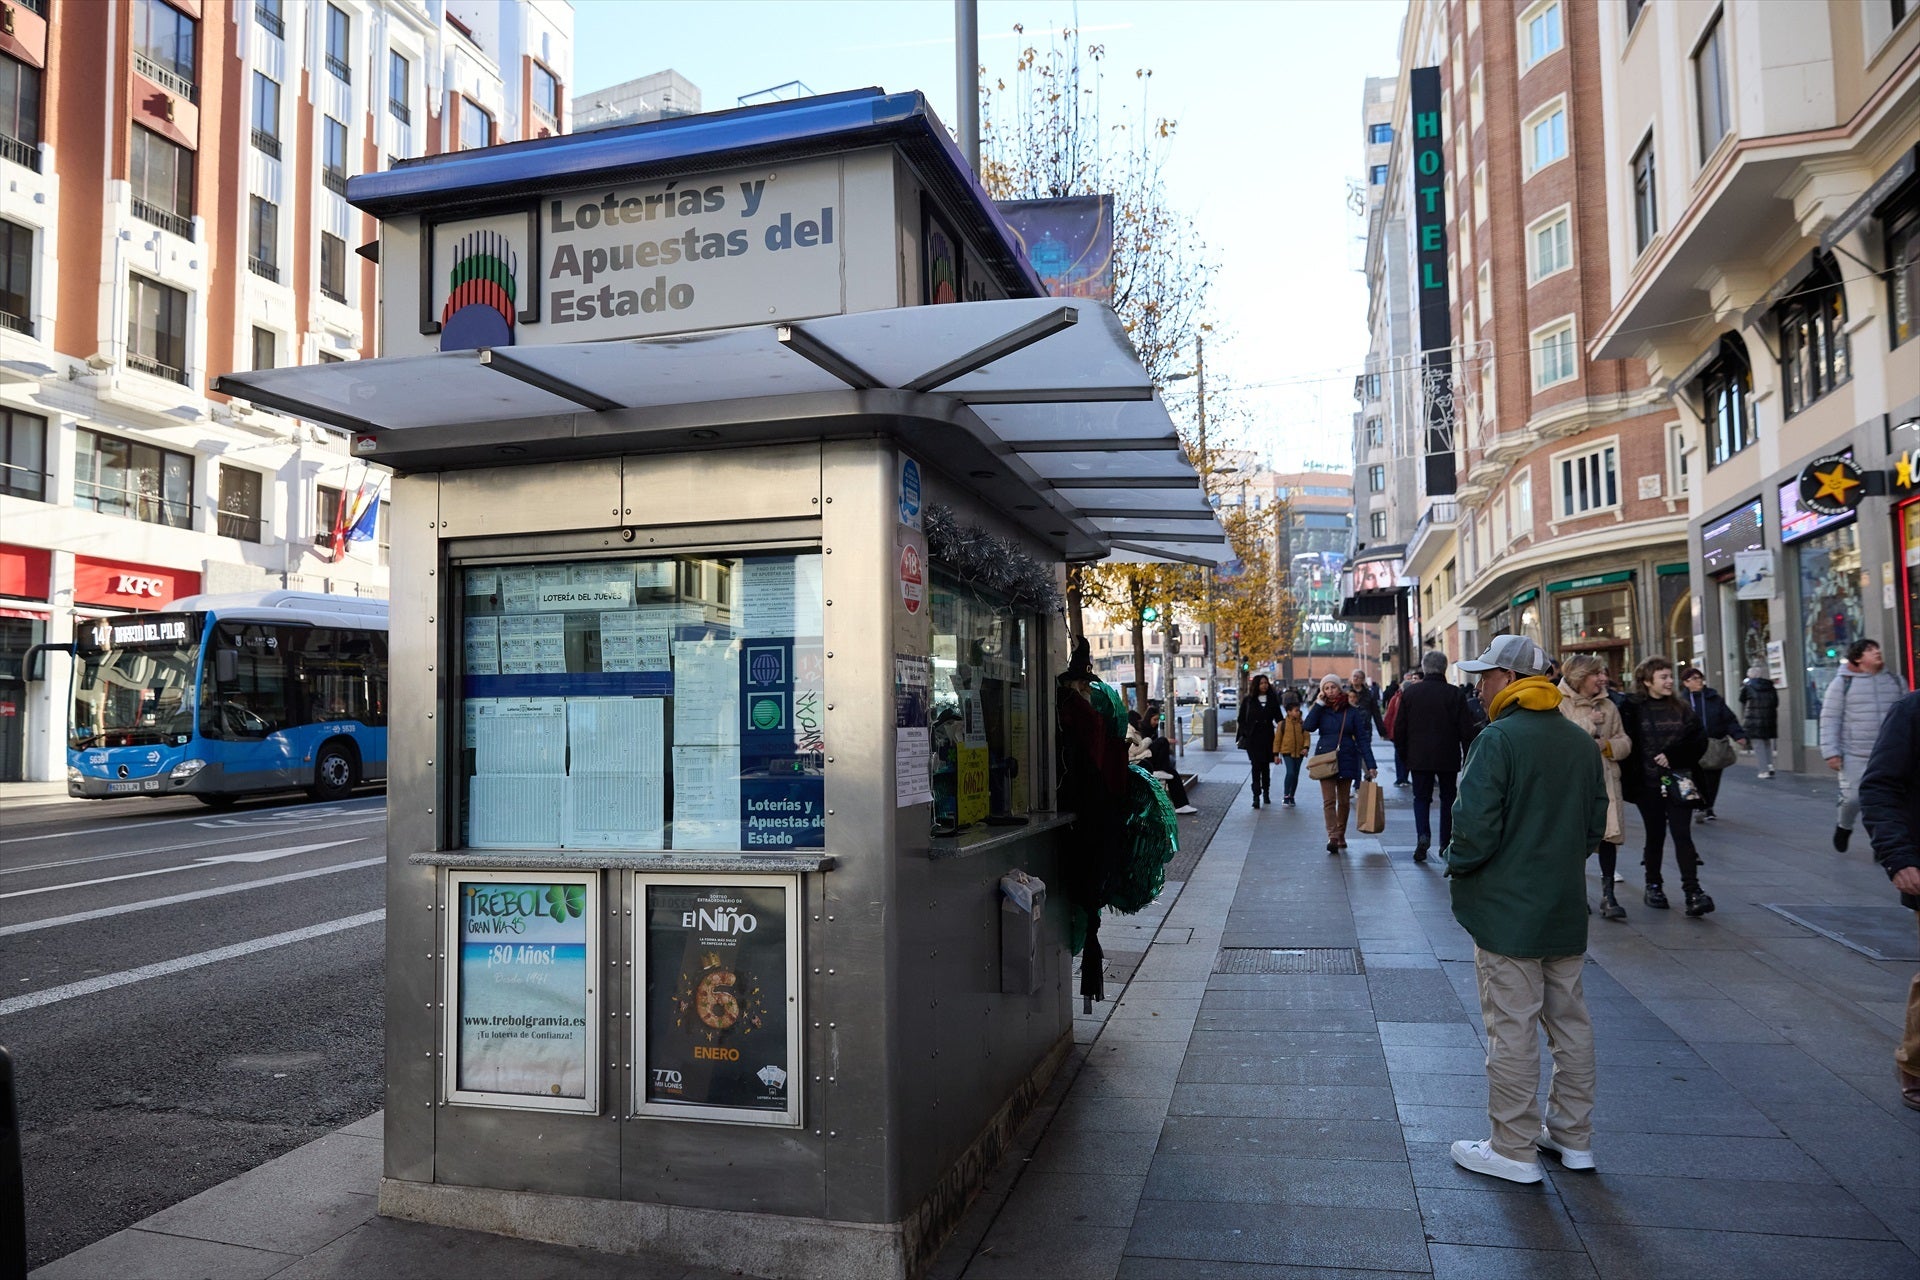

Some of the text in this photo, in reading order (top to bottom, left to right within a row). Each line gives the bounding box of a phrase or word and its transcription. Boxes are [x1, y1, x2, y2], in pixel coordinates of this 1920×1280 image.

[551, 179, 766, 233] Loterías y
[1417, 111, 1443, 289] HOTEL
[549, 207, 833, 284] Apuestas del
[551, 277, 695, 324] Estado
[1813, 456, 1863, 475] CALIFORNIA
[117, 574, 163, 597] KFC
[543, 591, 622, 602] LOTERÍA DEL JUEVES
[91, 622, 186, 646] 147 BARRIO DEL PILAR
[1302, 622, 1347, 633] NAVIDAD
[89, 755, 106, 764] 5639
[748, 798, 813, 813] Loterías y
[748, 815, 825, 830] Apuestas de
[748, 832, 793, 845] Estado
[464, 888, 550, 918] TRÉBOL
[468, 919, 491, 934] GRAN
[698, 906, 757, 935] Niño
[487, 945, 556, 968] ¡80 Años!
[696, 970, 739, 1030] 6
[464, 1015, 586, 1028] www.trebolgranvia.es
[520, 1031, 529, 1039] de
[531, 1031, 573, 1040] Confianza!
[694, 1046, 740, 1061] ENERO
[652, 1068, 683, 1083] 770
